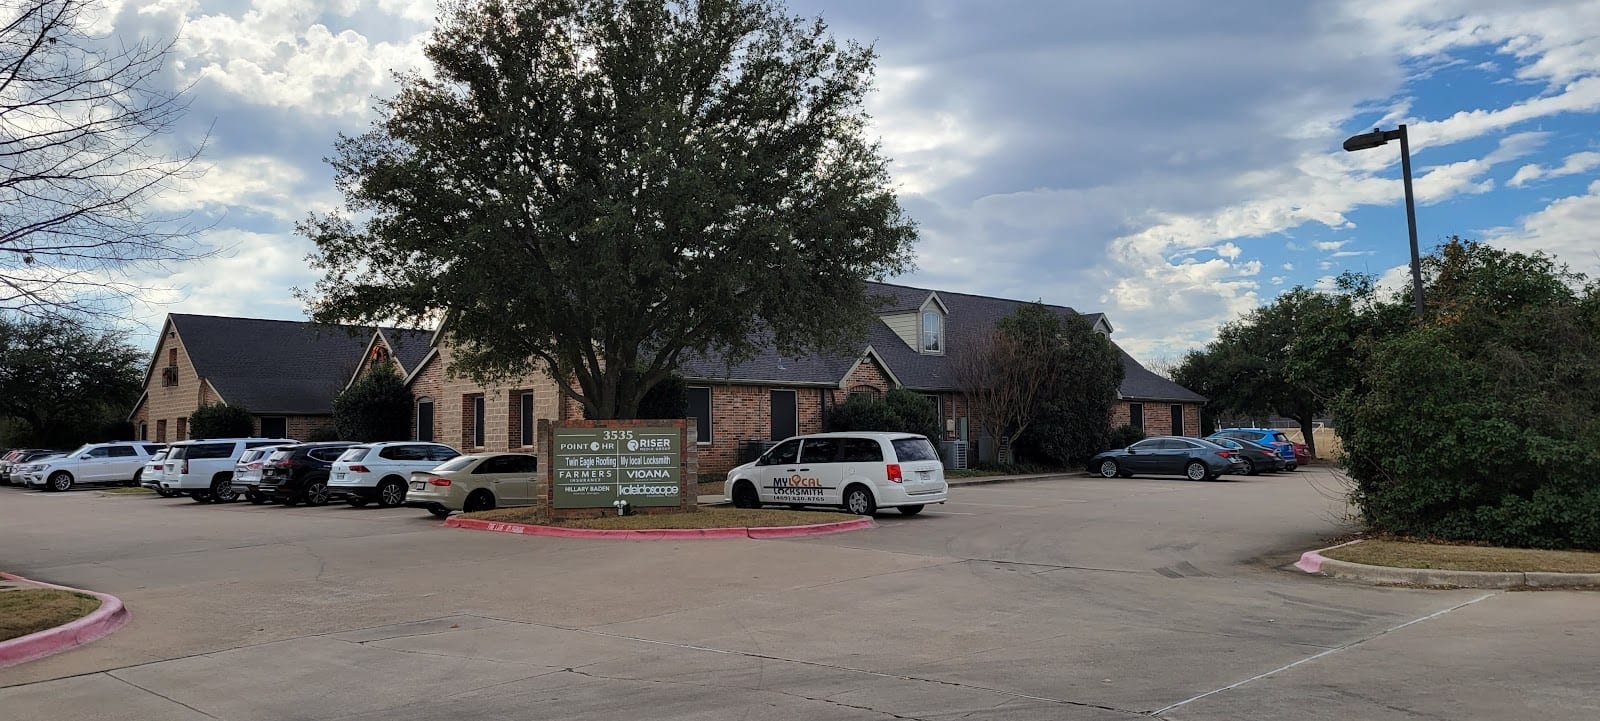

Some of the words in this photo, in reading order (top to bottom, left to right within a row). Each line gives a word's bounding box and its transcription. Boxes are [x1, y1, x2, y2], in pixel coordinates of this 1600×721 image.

[603, 430, 634, 440] 3535
[640, 439, 671, 448] RISER
[565, 457, 579, 466] Twin
[580, 457, 594, 468] Eagle
[596, 456, 616, 468] Roofing
[620, 456, 629, 468] My
[630, 456, 642, 465] local
[643, 456, 671, 465] Locksmith
[559, 470, 612, 478] FARMERS
[626, 470, 670, 478] VIOANA
[619, 484, 679, 496] kaleidoscope
[774, 488, 824, 496] LOCKSMITH
